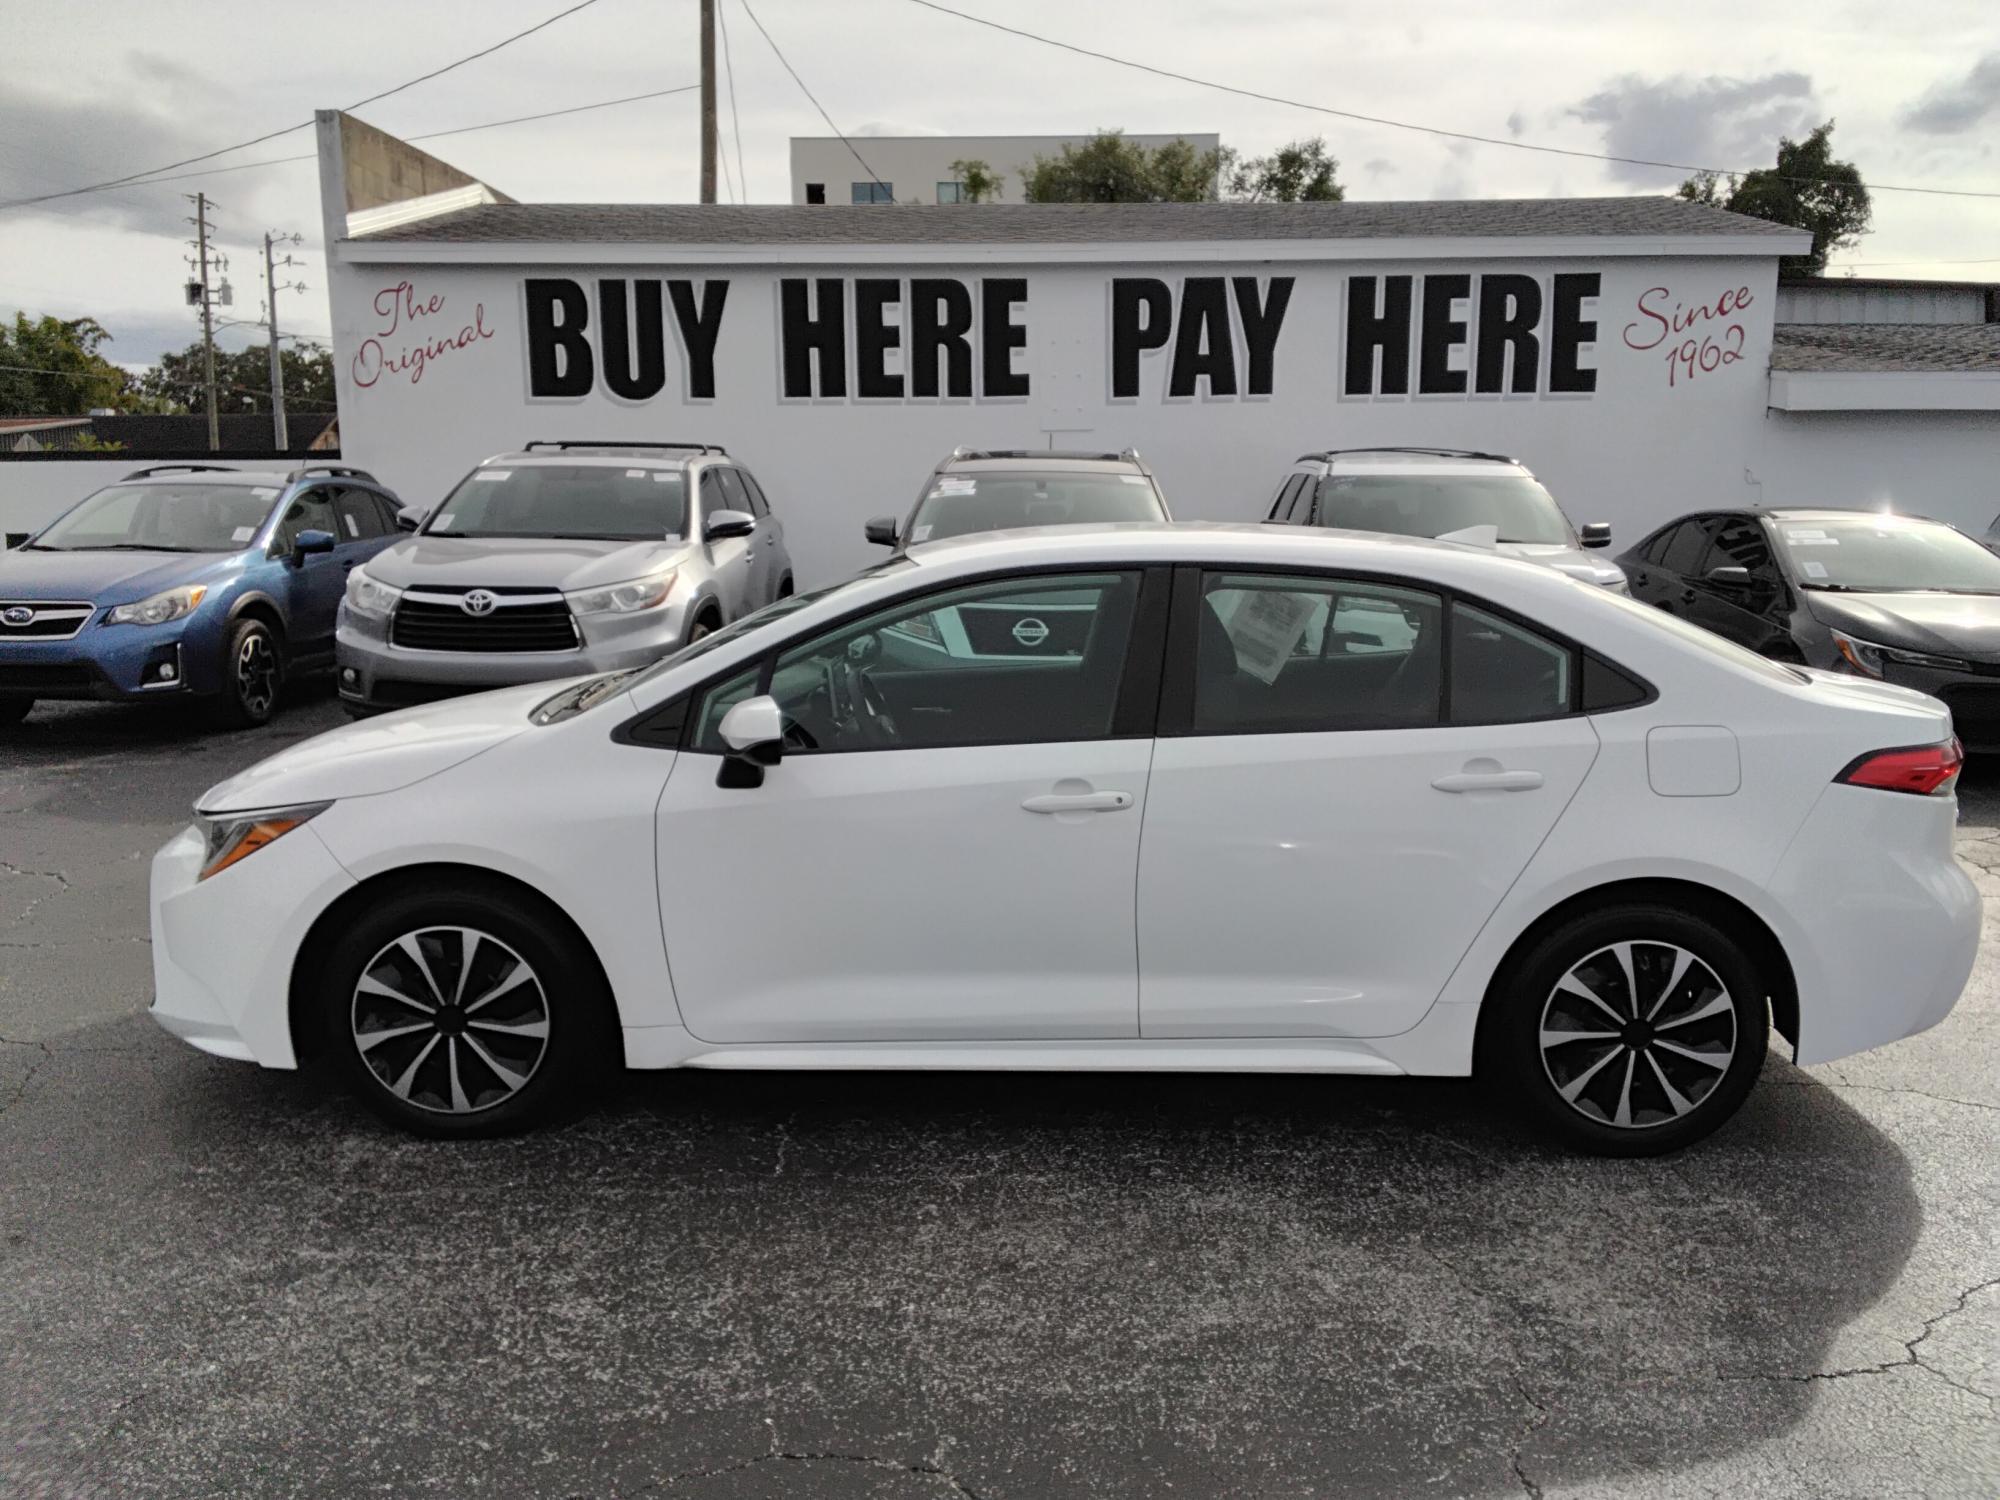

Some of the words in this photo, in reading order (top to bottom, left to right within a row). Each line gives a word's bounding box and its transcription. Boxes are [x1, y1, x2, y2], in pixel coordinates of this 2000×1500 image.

[374, 281, 445, 337] The
[524, 278, 730, 400] BUY
[780, 278, 1029, 398] HERE
[1112, 277, 1295, 397] PAY
[1345, 273, 1601, 395] HERE
[1623, 286, 1754, 350] Since
[352, 303, 495, 388] Original
[1665, 324, 1745, 388] 1962
